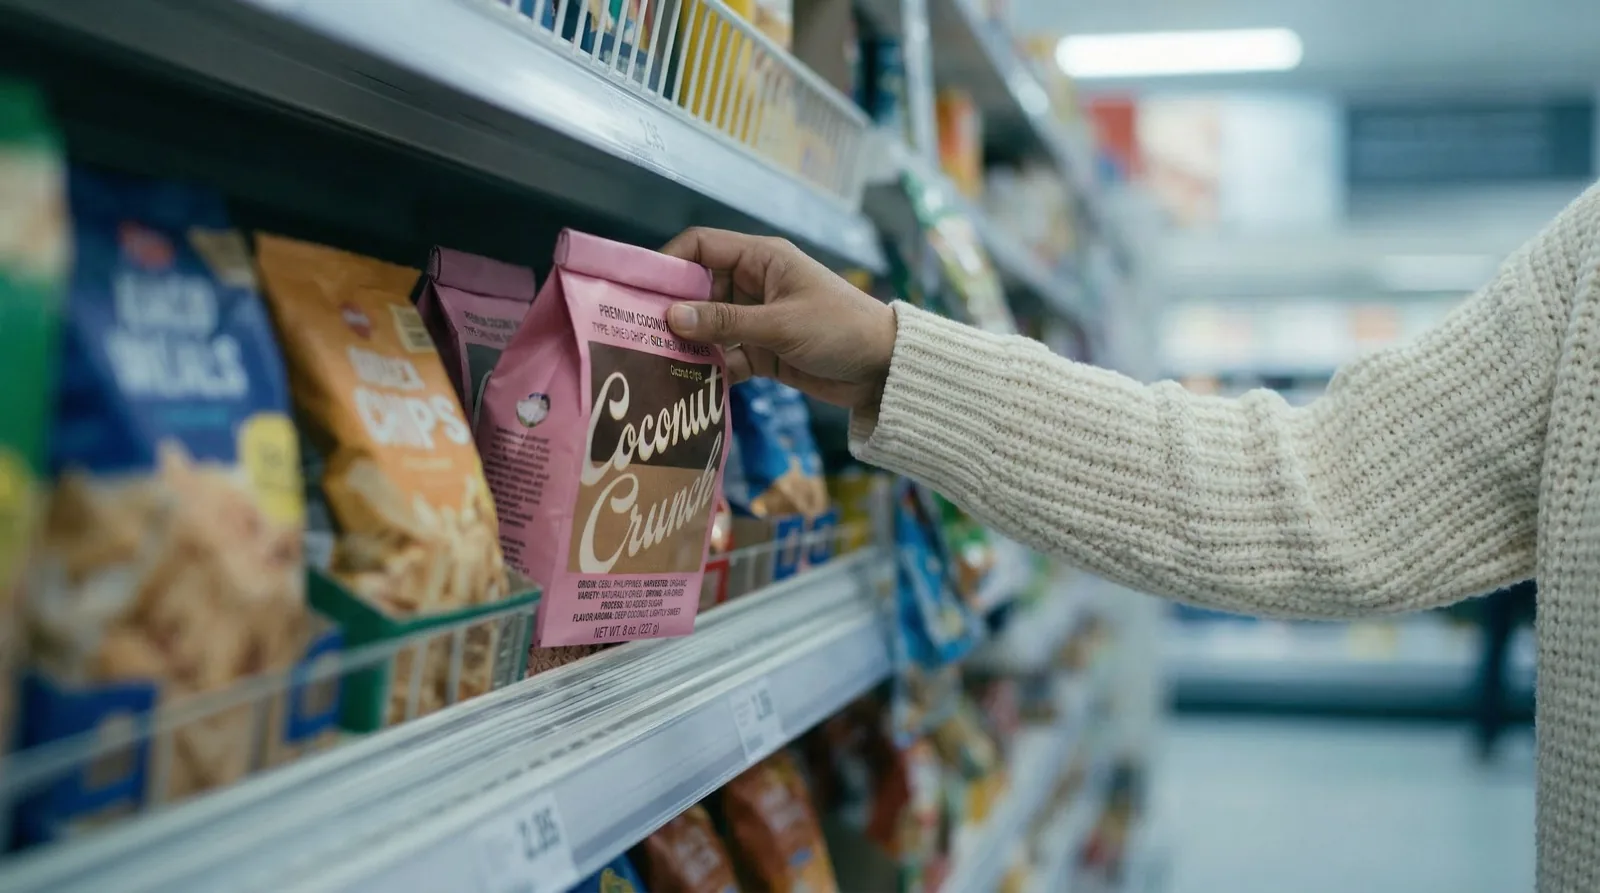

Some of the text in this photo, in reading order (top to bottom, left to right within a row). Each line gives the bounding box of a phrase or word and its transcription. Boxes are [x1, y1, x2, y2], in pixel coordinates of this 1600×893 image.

[598, 303, 636, 325] PREMIUM
[611, 325, 630, 340] DRIED
[630, 329, 648, 344] CHIPS
[580, 365, 725, 487] Coconut
[579, 431, 723, 574] Crunch
[577, 579, 598, 589] ORIGIN:
[669, 578, 687, 588] ORGANIC
[577, 590, 600, 600] VARIETY:
[600, 599, 663, 610] PROCESS: NO ADDED SUGAR
[614, 610, 627, 620] DEEP
[649, 608, 667, 618] LIGHTLY
[667, 607, 681, 616] SWEET
[593, 626, 609, 639] NET
[609, 625, 621, 637] WT.
[622, 624, 628, 636] 8
[638, 622, 652, 636] (227
[652, 622, 660, 635] g)
